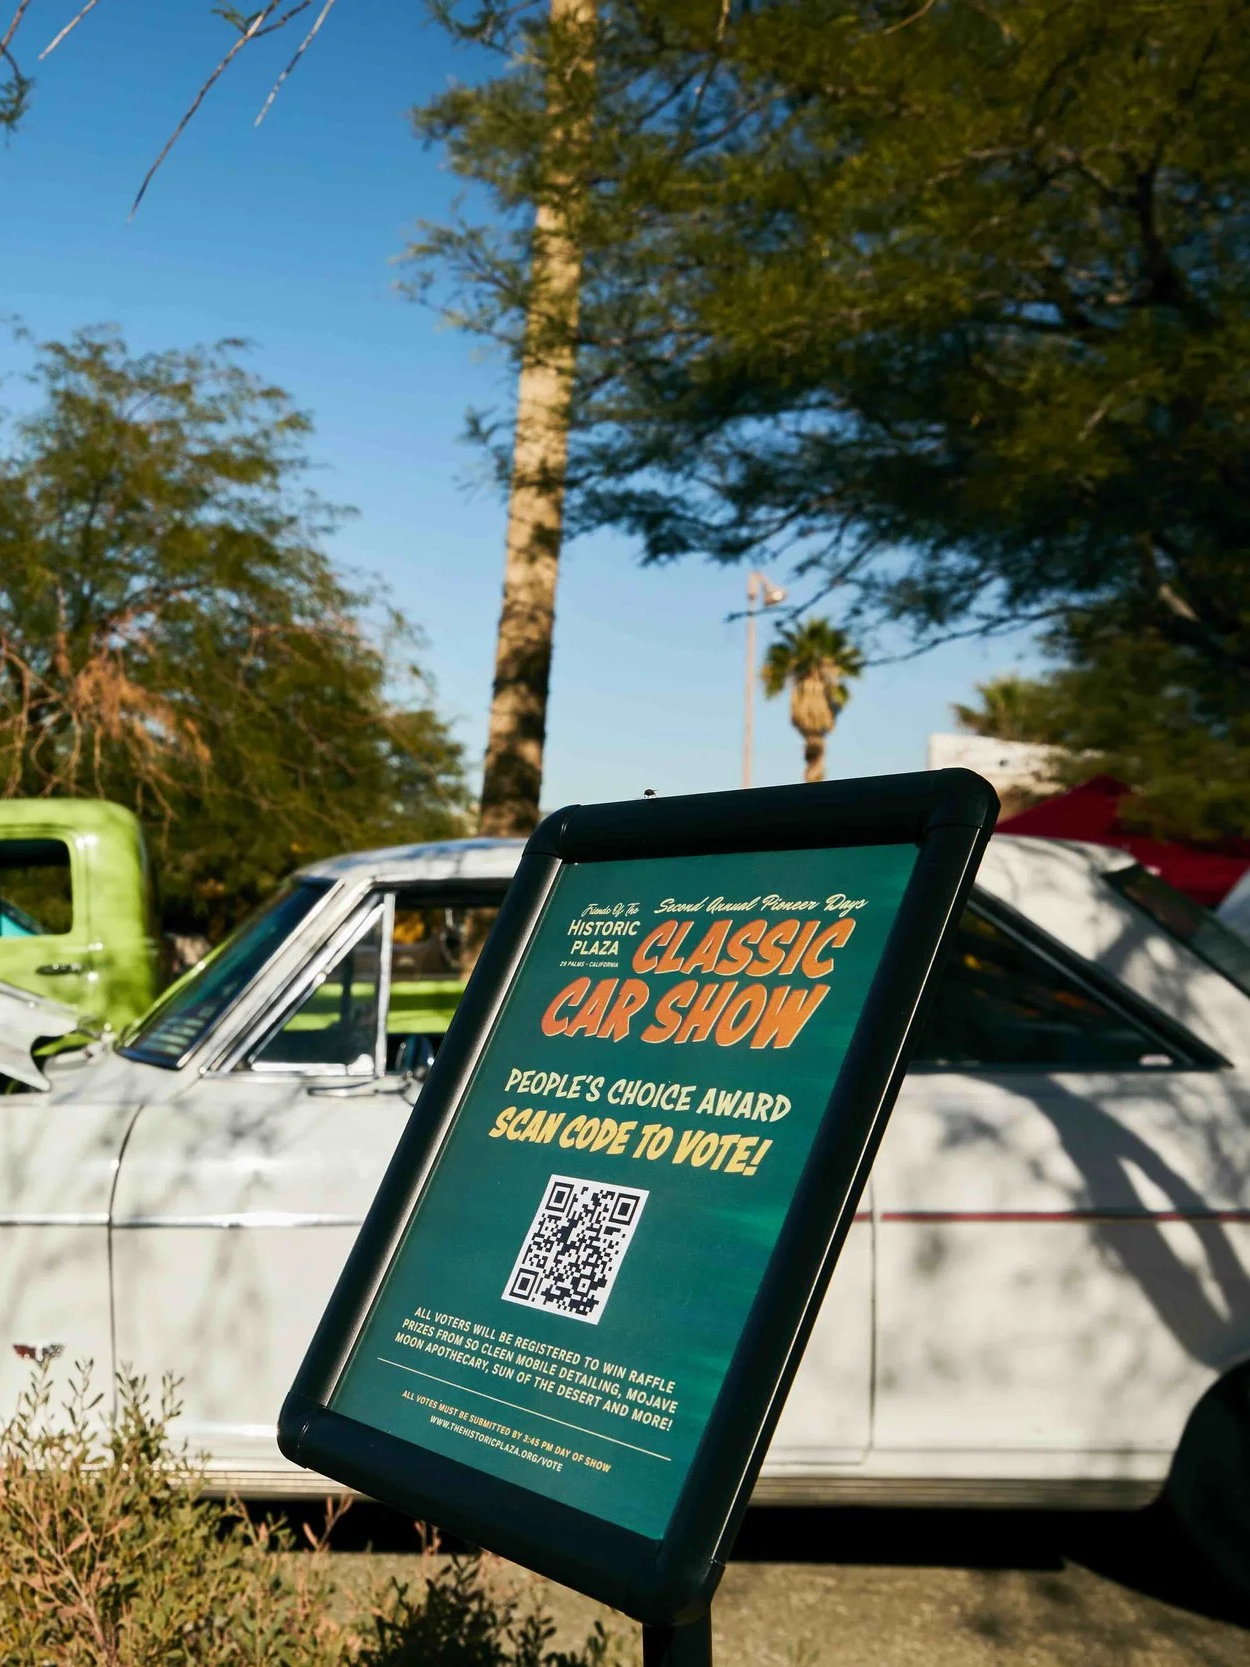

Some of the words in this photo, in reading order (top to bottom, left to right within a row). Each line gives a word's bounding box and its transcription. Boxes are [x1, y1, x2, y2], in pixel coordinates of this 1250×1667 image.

[567, 919, 641, 936] HISTORIC
[581, 903, 612, 917] Friends
[612, 902, 625, 917] Of
[625, 902, 641, 916] The
[654, 896, 709, 914] Second
[707, 896, 761, 914] Annual
[761, 895, 819, 912] Pioneer
[825, 894, 869, 917] Days
[570, 940, 619, 955] PLAZA
[631, 918, 856, 979] CLASSIC
[541, 977, 650, 1043] CAR
[641, 979, 831, 1050] SHOW
[504, 1068, 605, 1102] PEOPLE'S
[607, 1079, 696, 1112] CHOICE
[696, 1088, 792, 1123] AWARD
[488, 1106, 566, 1144] SCAN
[559, 1115, 638, 1155] CODE
[632, 1123, 674, 1161] TO
[672, 1129, 774, 1176] VOTE!
[402, 1318, 435, 1337] PRIZES
[435, 1329, 464, 1346] FROM
[464, 1338, 479, 1351] SO
[481, 1343, 514, 1362] CLEEN
[515, 1354, 558, 1376] MOBILE
[558, 1367, 622, 1399] DETAILING,
[626, 1388, 679, 1414] MOJAVE
[414, 1306, 432, 1321] ALL
[434, 1312, 472, 1332] VOTERS
[472, 1323, 496, 1340] WILL
[498, 1331, 514, 1345] BE
[514, 1336, 581, 1365] REGISTERED
[584, 1356, 600, 1371] TO
[602, 1362, 627, 1379] WIN
[628, 1370, 676, 1394] RAFFLE
[395, 1332, 425, 1350] MOON
[424, 1342, 489, 1374] APOTHECARY,
[492, 1364, 515, 1379] SUN
[516, 1372, 532, 1385] OF
[533, 1376, 556, 1393] THE
[556, 1384, 602, 1408] DESERT
[602, 1400, 629, 1417] AND
[631, 1408, 673, 1431] MORE!
[402, 1390, 414, 1401] ALL
[416, 1394, 438, 1409] VOTES
[438, 1403, 459, 1416] MUST
[459, 1410, 469, 1420] BE
[468, 1414, 511, 1436] SUBMITTED
[511, 1430, 523, 1440] BY
[522, 1434, 541, 1447] 3:45
[541, 1441, 554, 1452] PM
[554, 1445, 571, 1458] DAY
[572, 1452, 585, 1463] OF
[584, 1457, 612, 1473] SHOW
[429, 1415, 563, 1472] WWW.THEHISTORICPLAZA.ORG/VOTE
